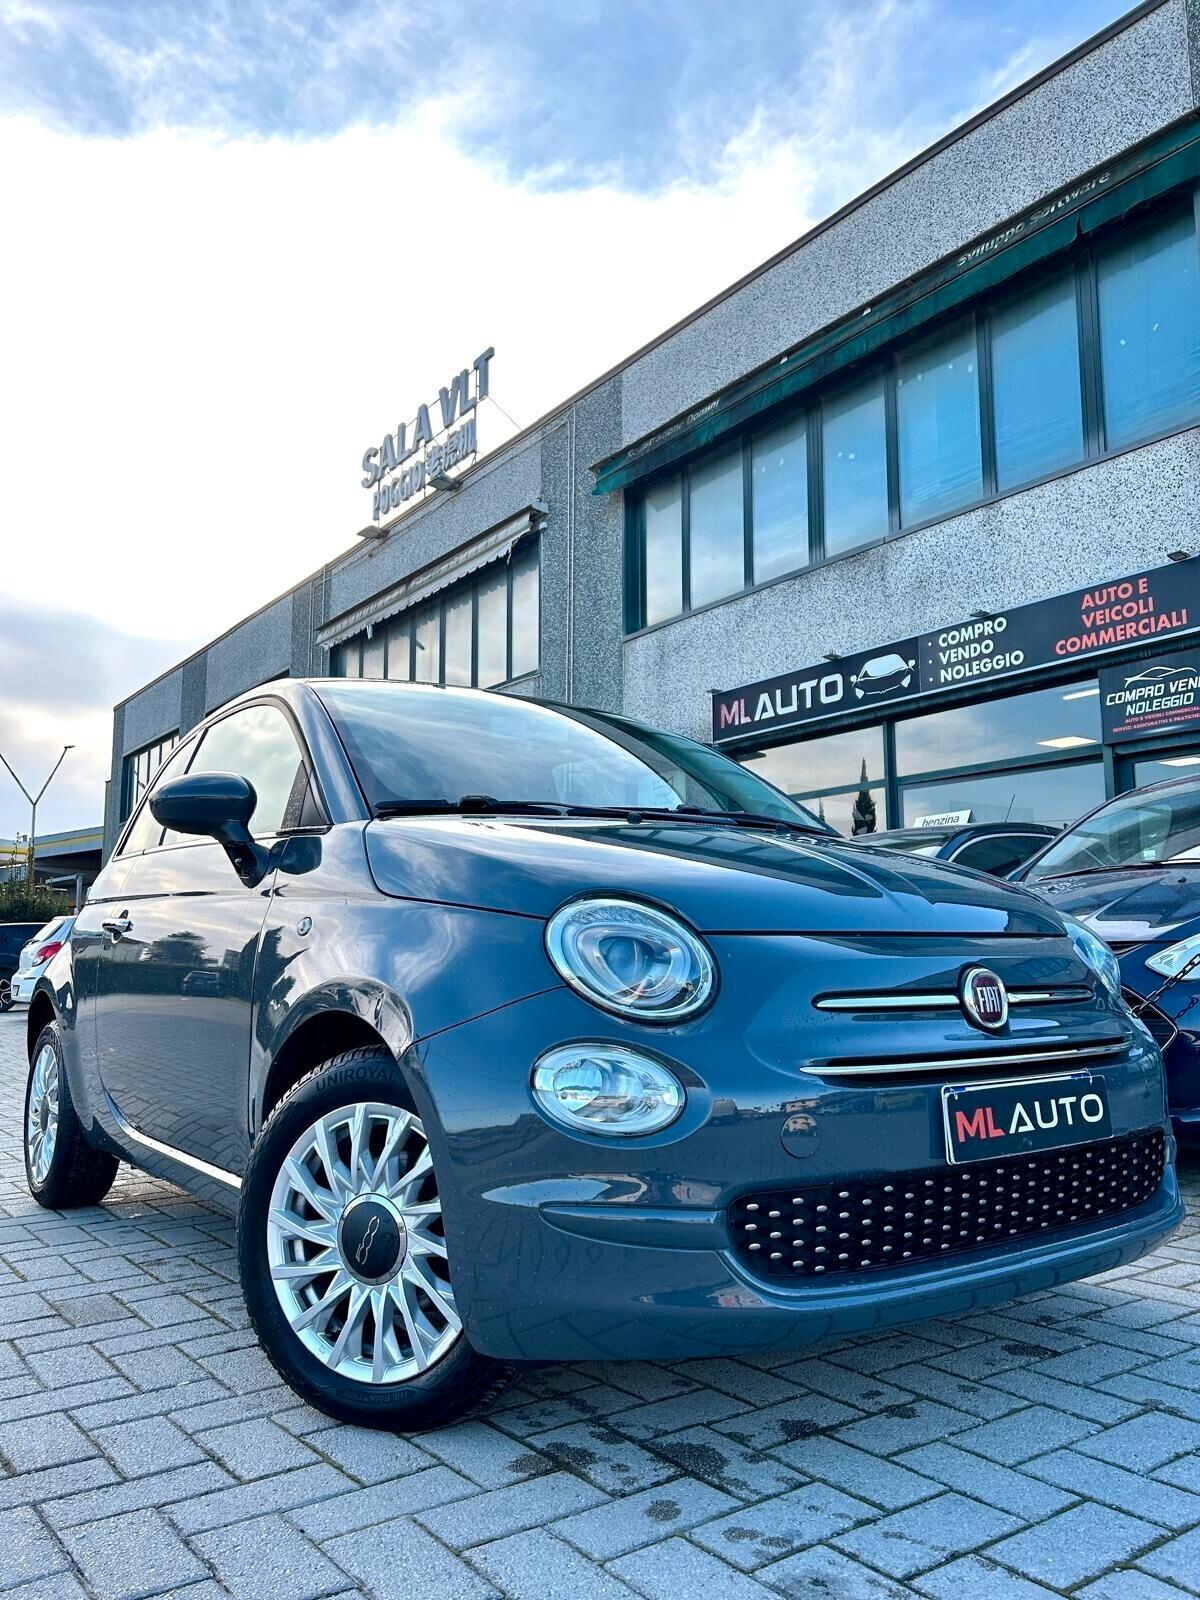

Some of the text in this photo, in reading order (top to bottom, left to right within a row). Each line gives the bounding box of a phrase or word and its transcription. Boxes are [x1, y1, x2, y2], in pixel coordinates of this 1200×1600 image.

[361, 346, 495, 489] SALA VLT
[373, 461, 426, 521] POGGIO
[1081, 577, 1148, 610] AUTO E
[1082, 597, 1154, 629] VEICOLI
[938, 616, 1007, 648] COMPRO
[1055, 608, 1188, 656] COMMERCIALI
[939, 639, 994, 665] VENDO
[940, 650, 1025, 683] NOLEGGIO
[1106, 675, 1200, 706] COMPRO VEN
[1126, 692, 1195, 716] NOLEGGIO
[1165, 705, 1200, 716] COMMERCIAL
[975, 984, 1001, 1013] FIAT
[316, 1066, 397, 1092] UNIROYAL
